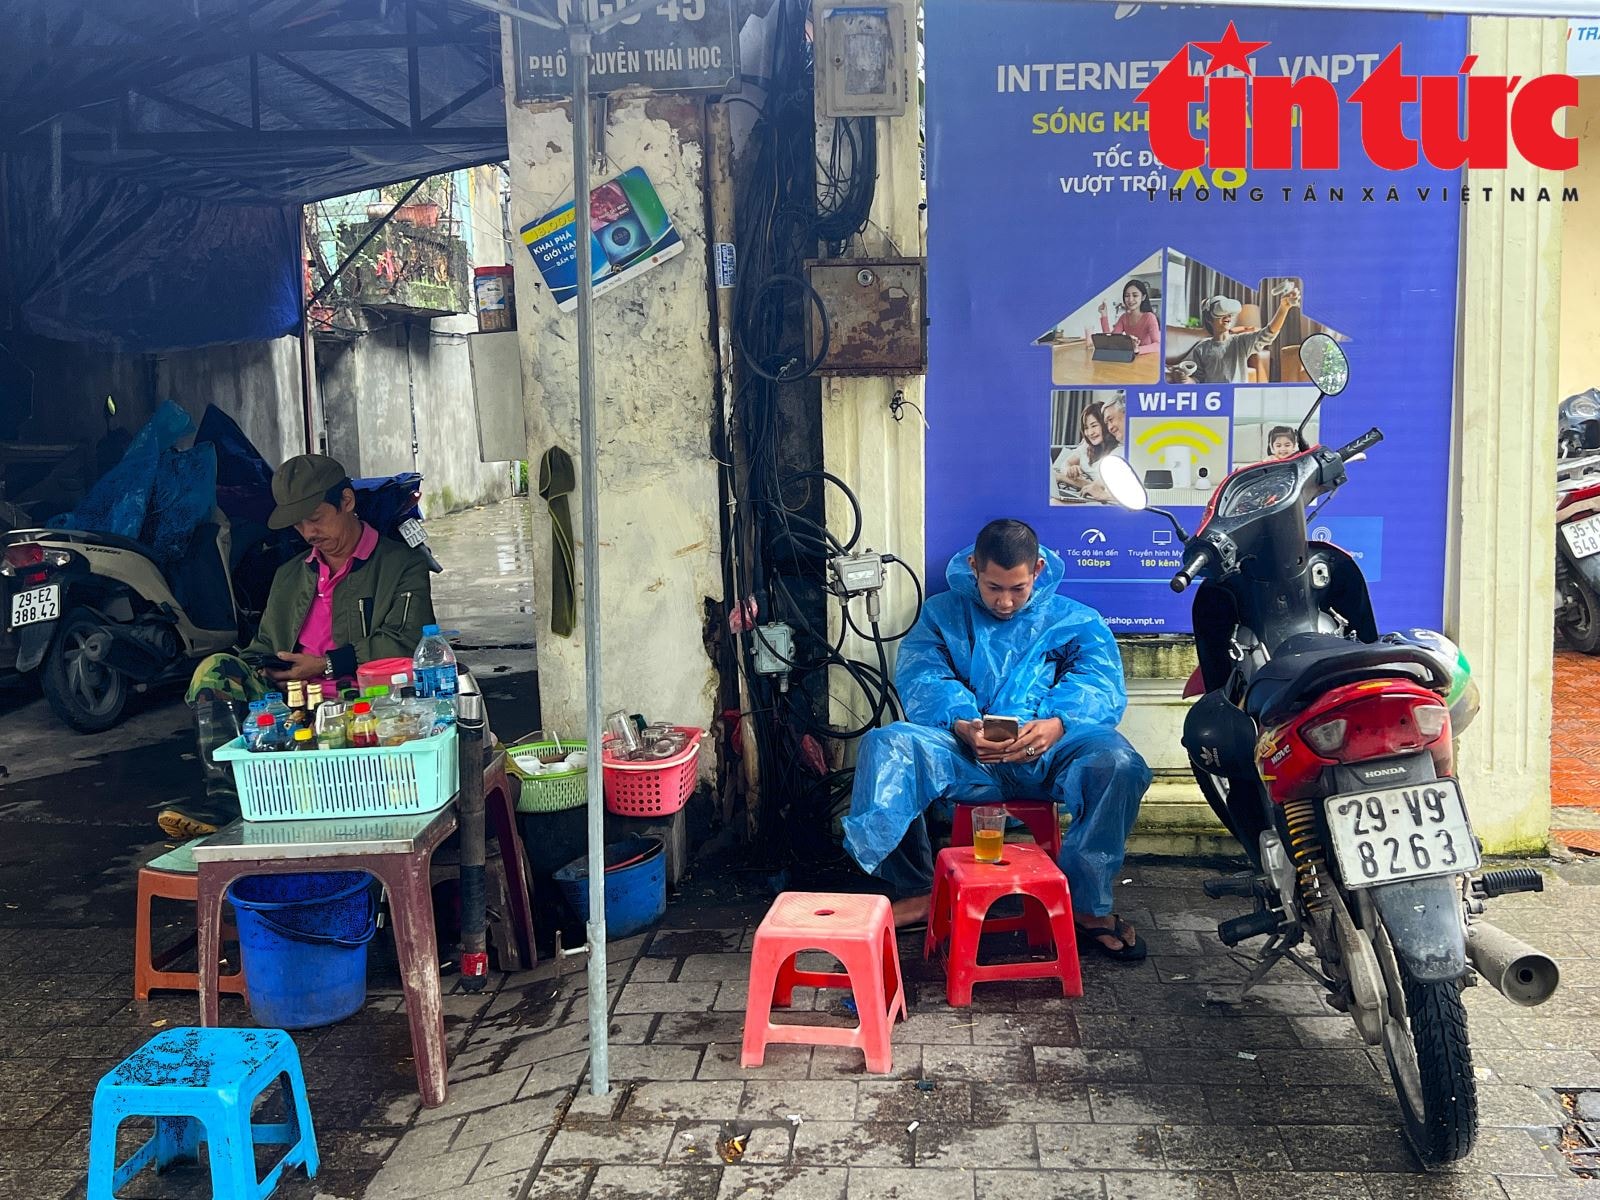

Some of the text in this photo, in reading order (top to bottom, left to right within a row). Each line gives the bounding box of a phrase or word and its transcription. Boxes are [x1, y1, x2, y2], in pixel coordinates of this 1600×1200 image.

[656, 0, 706, 22] 45
[1578, 27, 1600, 41] TR
[529, 47, 567, 78] PHỐ
[644, 42, 683, 72] THÁI
[688, 46, 721, 75] HỌC
[1279, 54, 1380, 88] VNPT
[1032, 106, 1105, 134] SÓNG
[1092, 143, 1133, 168] TỐC
[1060, 170, 1167, 197] VƯỢT TRỘI
[532, 230, 572, 255] KHAI PHÁ
[543, 247, 562, 262] GIỚI
[1138, 391, 1221, 411] WI-FI 6
[1092, 549, 1104, 557] lên
[1573, 534, 1600, 555] 548
[1077, 558, 1111, 568] 10Gbps
[1140, 558, 1181, 567] 180 kênh
[18, 587, 52, 609] 29-E2
[14, 602, 56, 625] 388.42
[1102, 616, 1165, 627] gishop.vnpt.vn
[1364, 766, 1408, 779] HONDA
[1346, 787, 1446, 836] 29-V9
[1357, 829, 1458, 879] 8263
